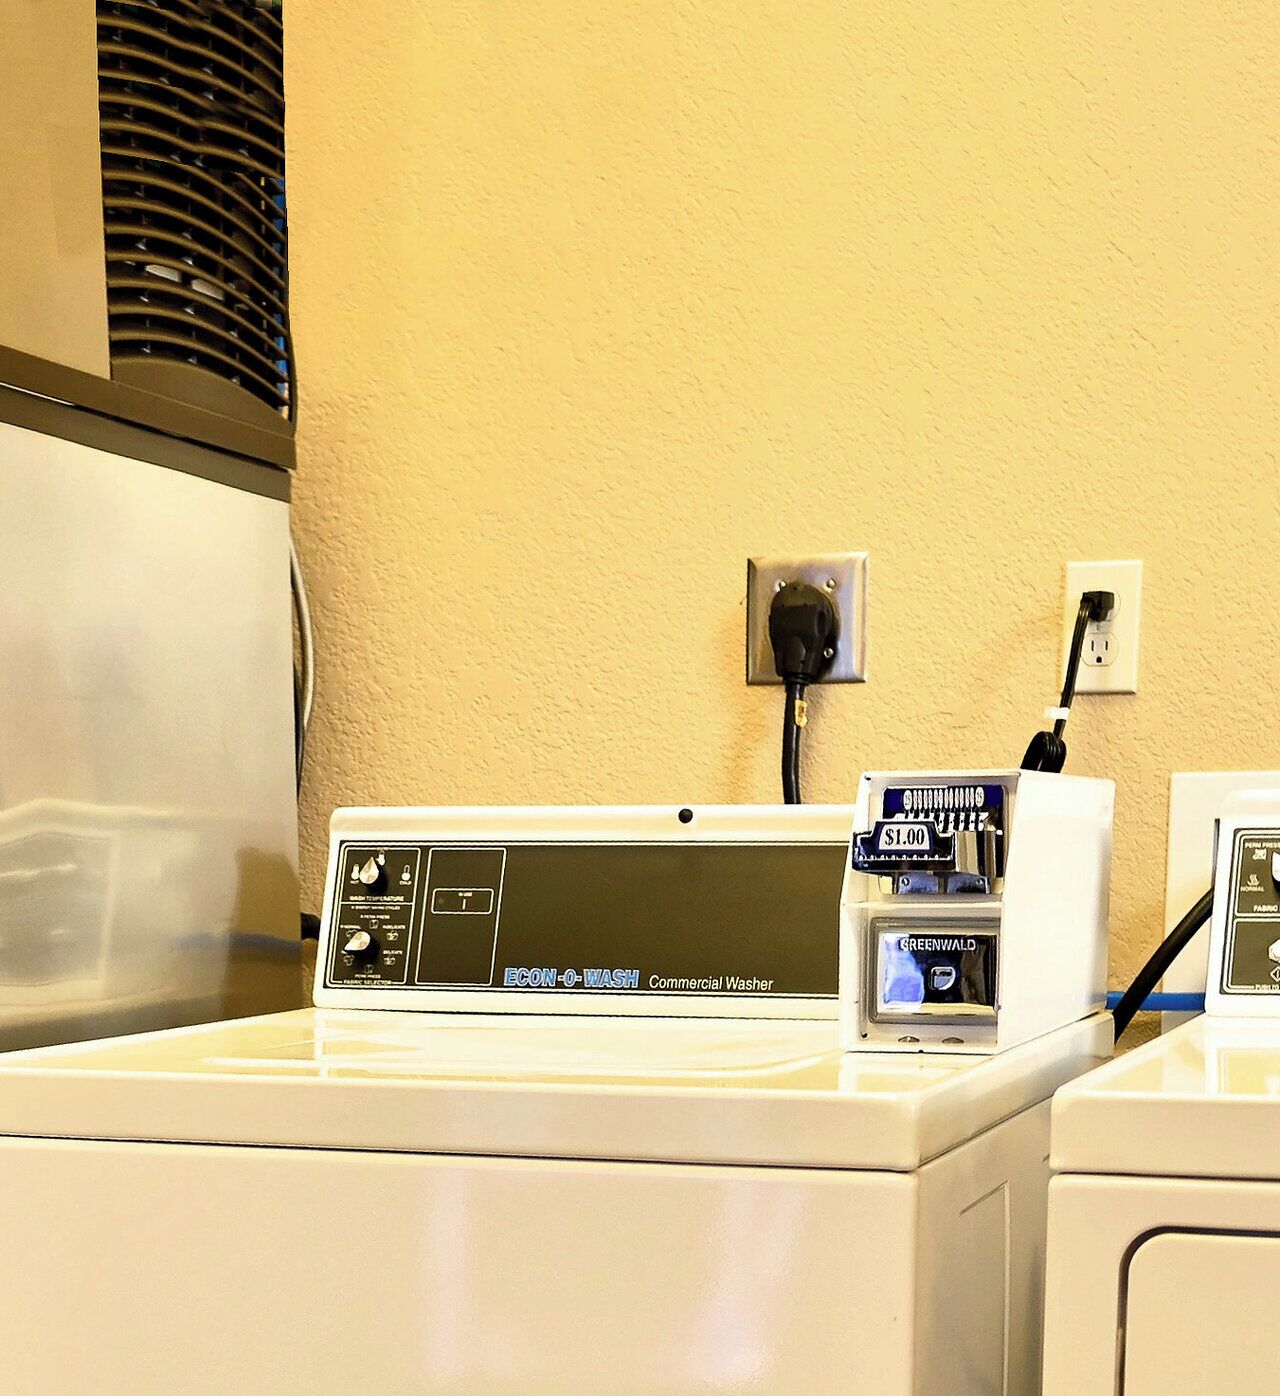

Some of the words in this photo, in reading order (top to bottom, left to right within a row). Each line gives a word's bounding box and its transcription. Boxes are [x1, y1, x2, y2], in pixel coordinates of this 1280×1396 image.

[884, 828, 926, 846] $1.00
[1253, 905, 1278, 913] FABRIC
[900, 938, 977, 951] GREENWALD
[504, 967, 640, 989] ECON-O-WASH
[648, 974, 724, 990] Commercial
[725, 976, 775, 992] Washer
